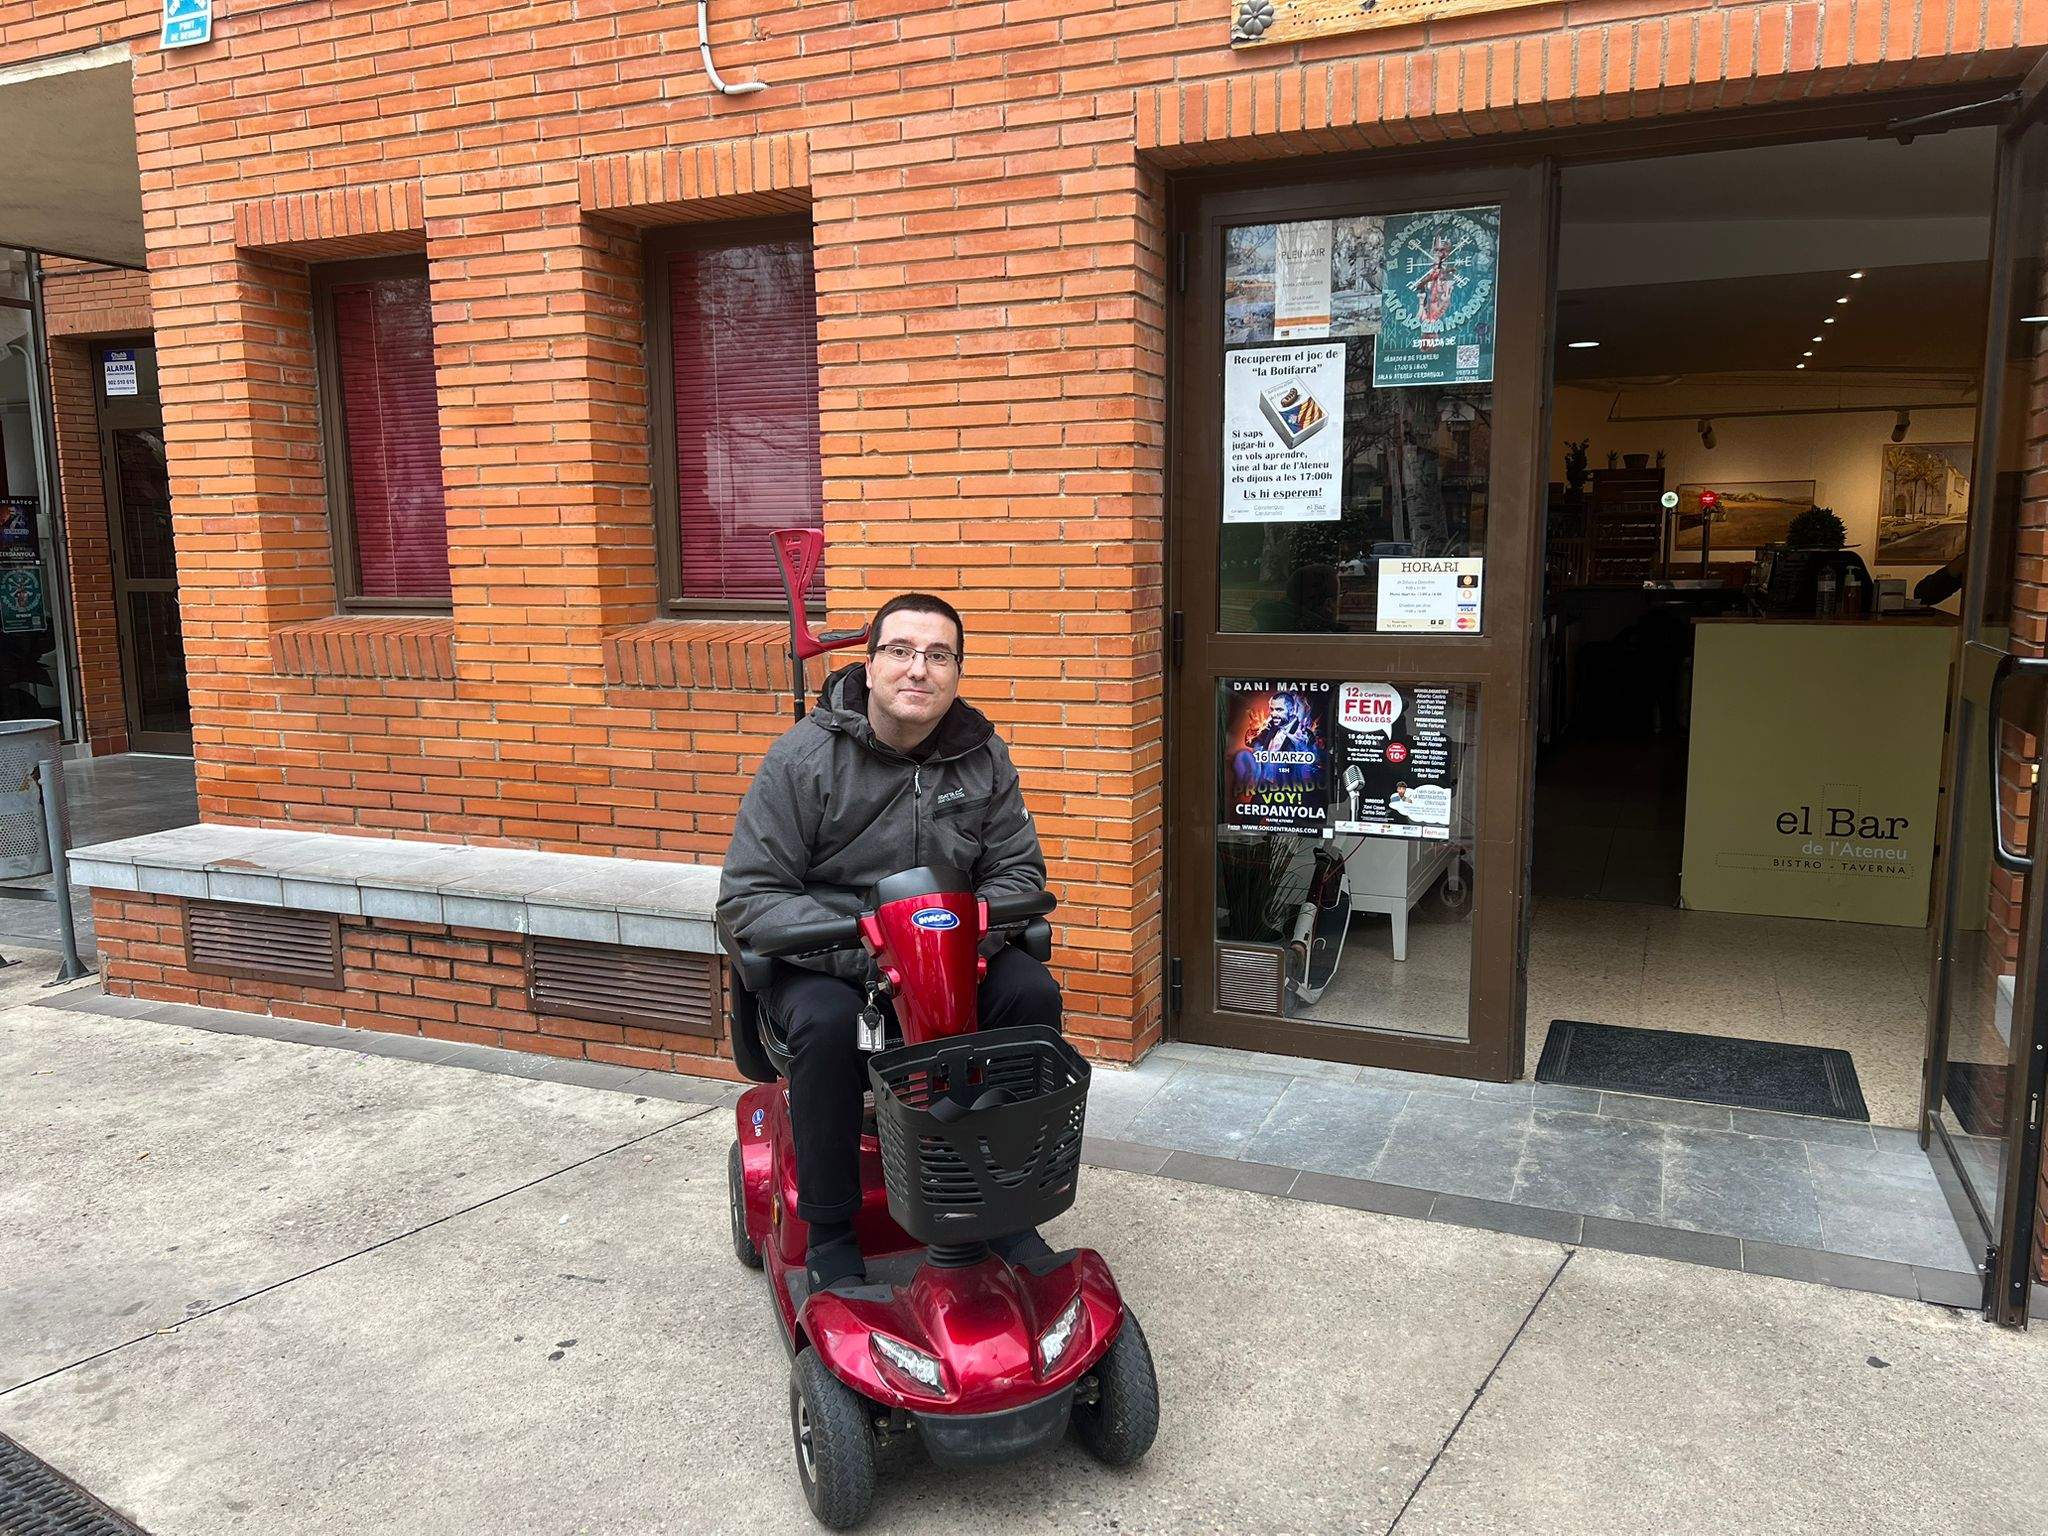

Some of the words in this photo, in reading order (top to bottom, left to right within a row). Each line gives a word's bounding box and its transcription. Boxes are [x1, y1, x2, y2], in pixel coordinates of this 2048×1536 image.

[1281, 250, 1307, 260] PLEIN
[1311, 248, 1326, 257] AIR
[1234, 352, 1291, 365] Recuperem
[1294, 351, 1304, 361] el
[1307, 350, 1323, 362] joc
[1326, 349, 1339, 359] de
[106, 364, 135, 372] ALARMA
[1232, 430, 1241, 438] Si
[1243, 430, 1263, 439] saps
[1232, 440, 1266, 451] jugar-hi
[1232, 453, 1243, 461] en
[1245, 452, 1262, 460] vols
[1265, 451, 1308, 461] aprendre,
[1232, 464, 1249, 472] vine
[1252, 463, 1260, 471] al
[1263, 463, 1278, 471] bar
[1280, 462, 1291, 470] de
[1232, 475, 1244, 483] els
[1246, 474, 1273, 484] dijous
[1284, 473, 1297, 481] les
[1300, 471, 1333, 480] 17:00h
[1243, 489, 1256, 499] Us
[1259, 489, 1270, 498] hi
[1273, 488, 1323, 499] esperem!
[1401, 561, 1459, 573] HORARI
[1233, 682, 1269, 691] DANI
[1277, 682, 1330, 692] MATEO
[1345, 699, 1391, 715] FEM
[1365, 733, 1384, 741] febrer
[1254, 752, 1268, 762] 16
[1271, 752, 1314, 762] MARZO
[1233, 780, 1327, 797] PROBANDO
[1262, 792, 1302, 805] VOY!
[1235, 804, 1326, 819] CERDANYOLA
[1776, 806, 1812, 835] el
[1825, 807, 1909, 840] Bar
[1802, 840, 1824, 855] de
[1830, 841, 1909, 860] l'Ateneu
[1773, 858, 1822, 870] BISTRO
[1842, 862, 1906, 875] TAVERNA
